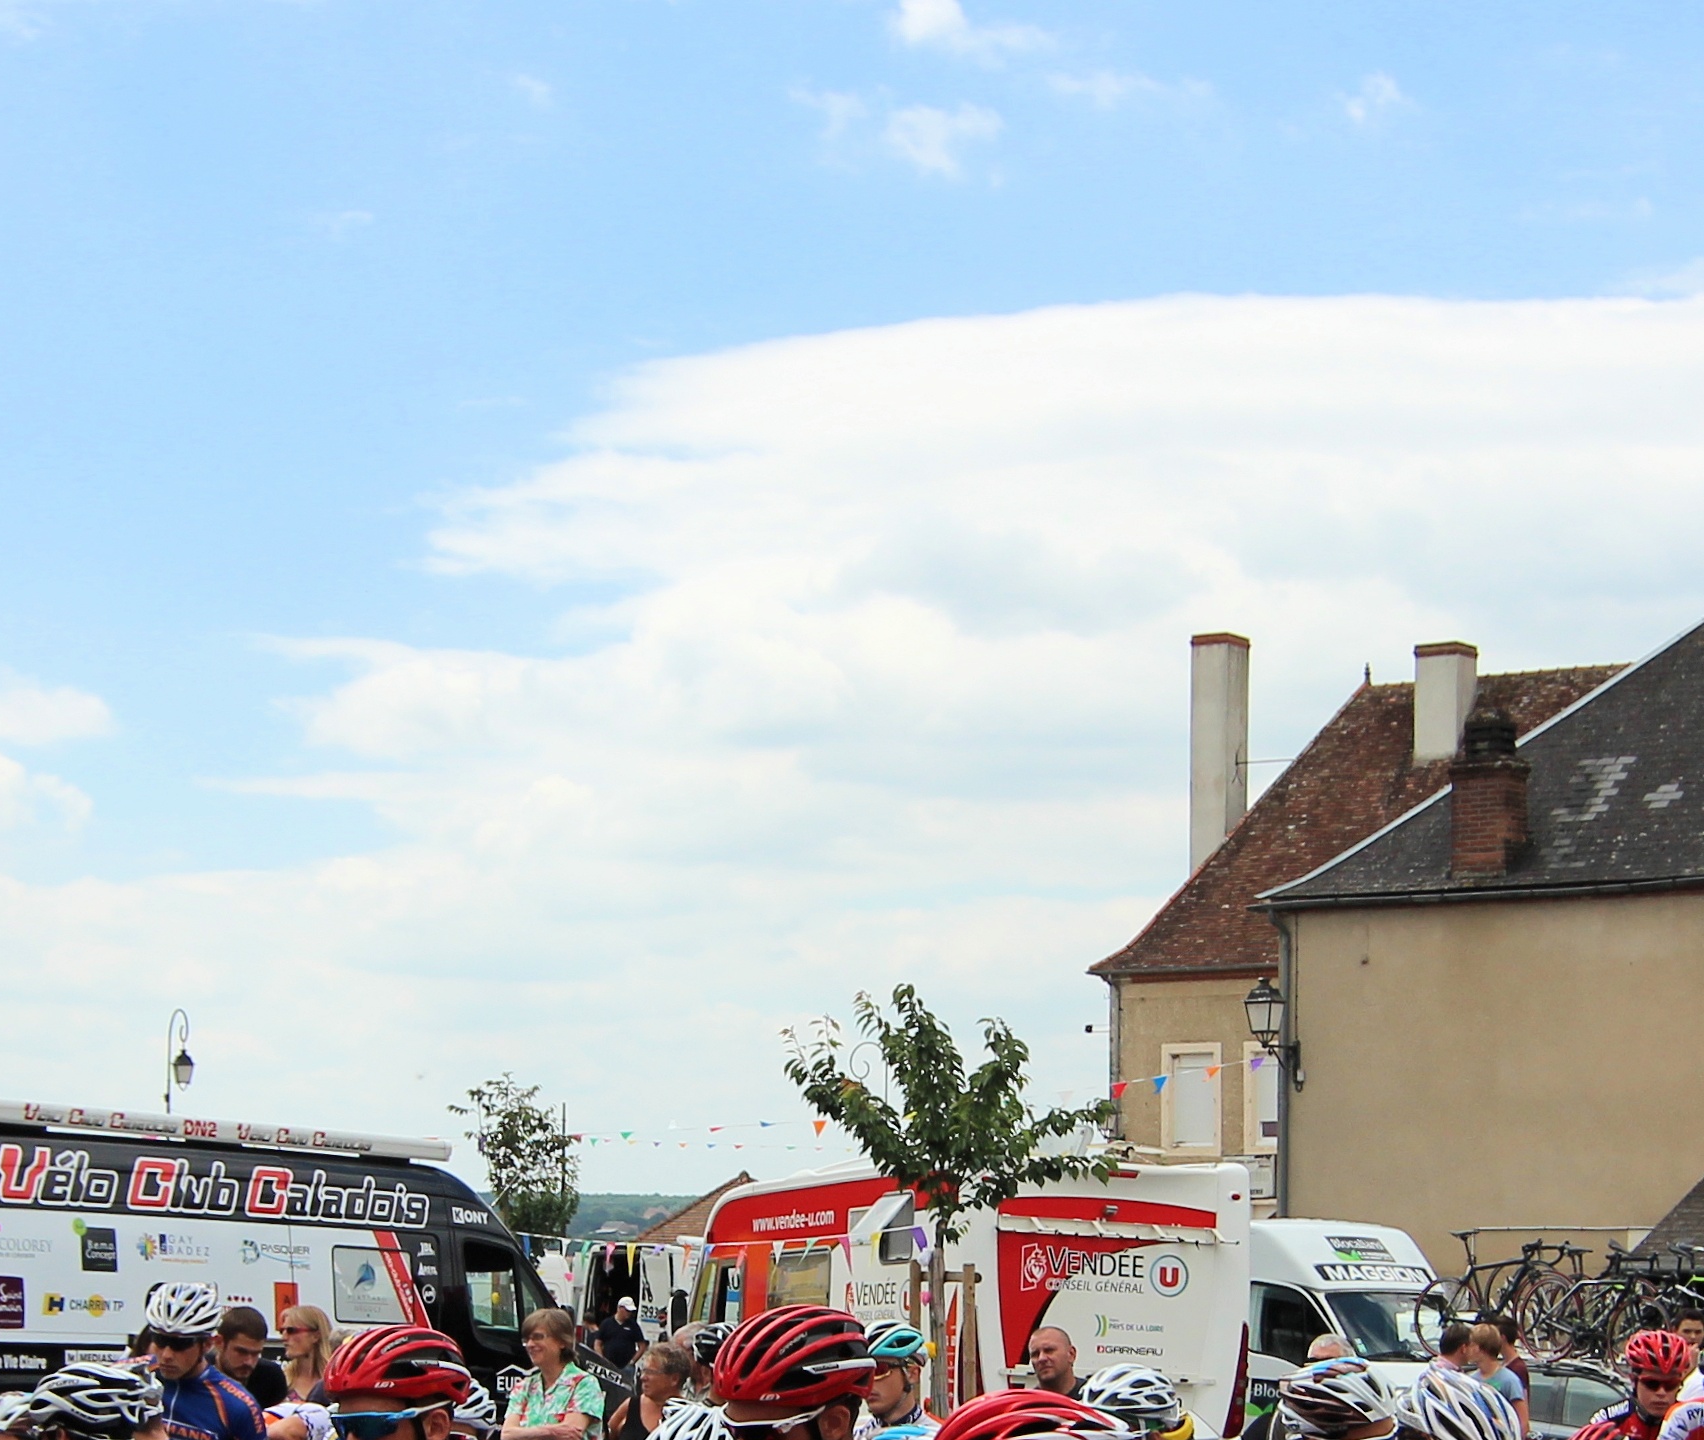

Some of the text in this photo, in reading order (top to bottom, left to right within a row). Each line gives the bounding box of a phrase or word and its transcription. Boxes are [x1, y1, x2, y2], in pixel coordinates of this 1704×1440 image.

[184, 1119, 217, 1137] DN2
[126, 1157, 239, 1215] Club
[245, 1166, 430, 1228] Caladois
[452, 1207, 489, 1225] KONY
[752, 1210, 835, 1233] www.vendee-u.com
[261, 1243, 310, 1255] PASQUIER
[1047, 1246, 1144, 1278] VENDÉE
[1046, 1277, 1144, 1294] CONSEIL GÉNÉRAL
[1159, 1266, 1179, 1288] U
[856, 1276, 896, 1305] VENDÉE
[69, 1299, 124, 1311] CHARRIN TP
[1105, 1346, 1163, 1356] GARNEAU
[3, 1354, 16, 1369] Vie
[17, 1355, 46, 1370] Claire
